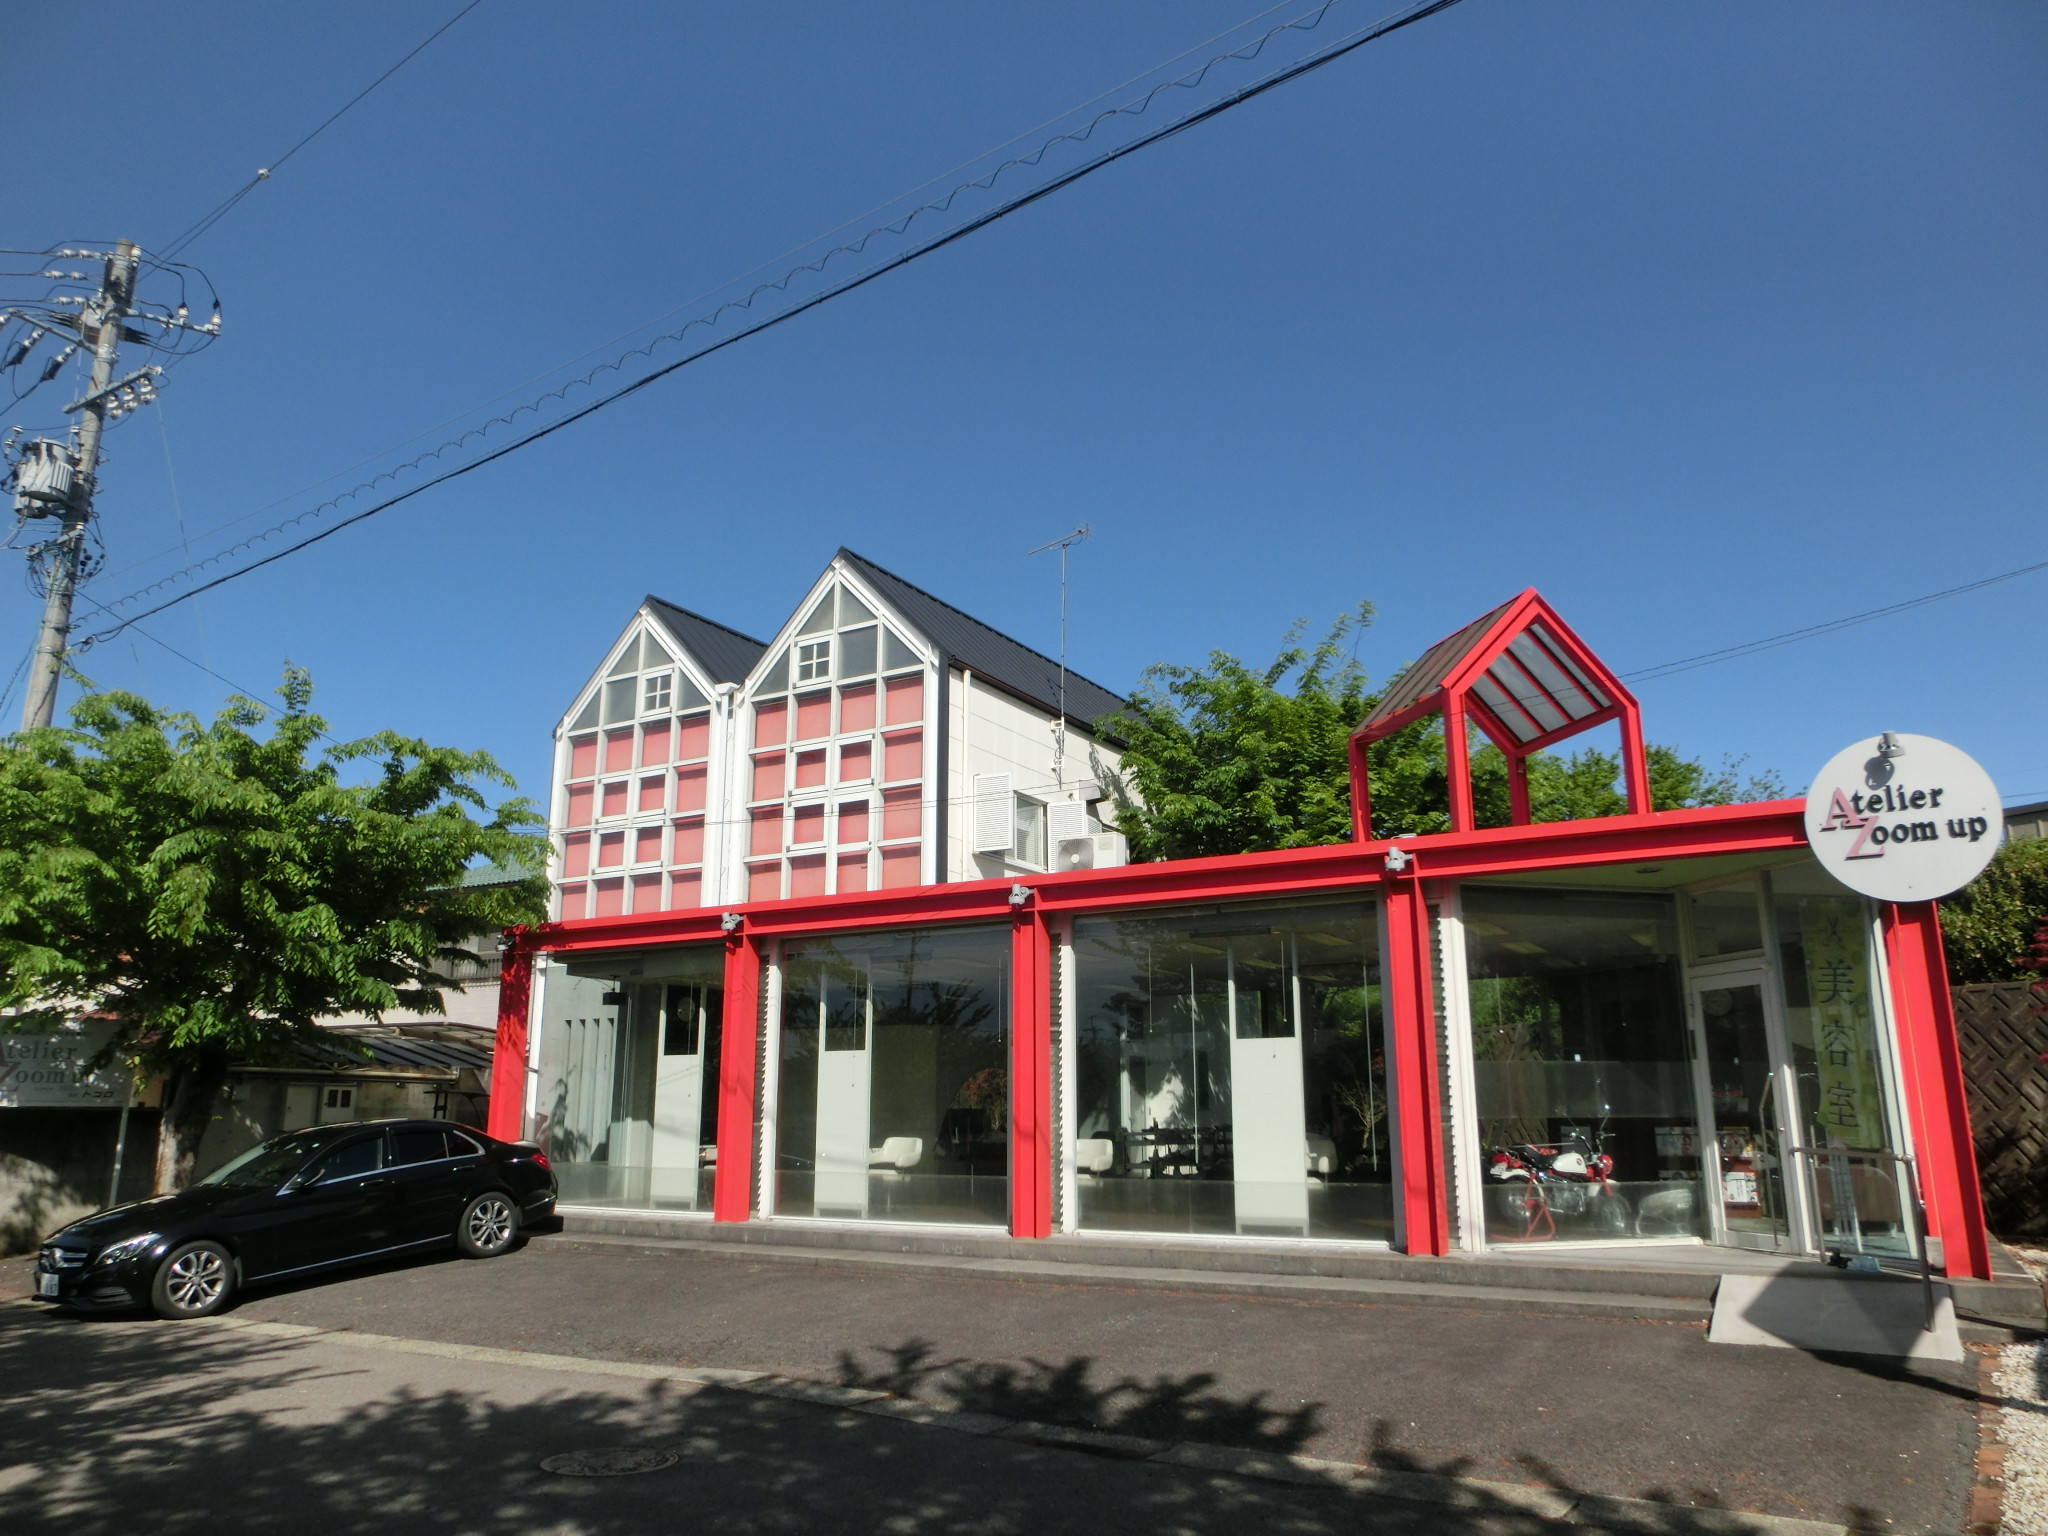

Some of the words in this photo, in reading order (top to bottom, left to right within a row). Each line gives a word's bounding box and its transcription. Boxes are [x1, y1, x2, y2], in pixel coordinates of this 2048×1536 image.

[1820, 784, 1943, 831] Atelier
[1845, 815, 1938, 860] Zoom
[1947, 816, 1988, 842] up
[1816, 959, 1861, 1128] 美容室
